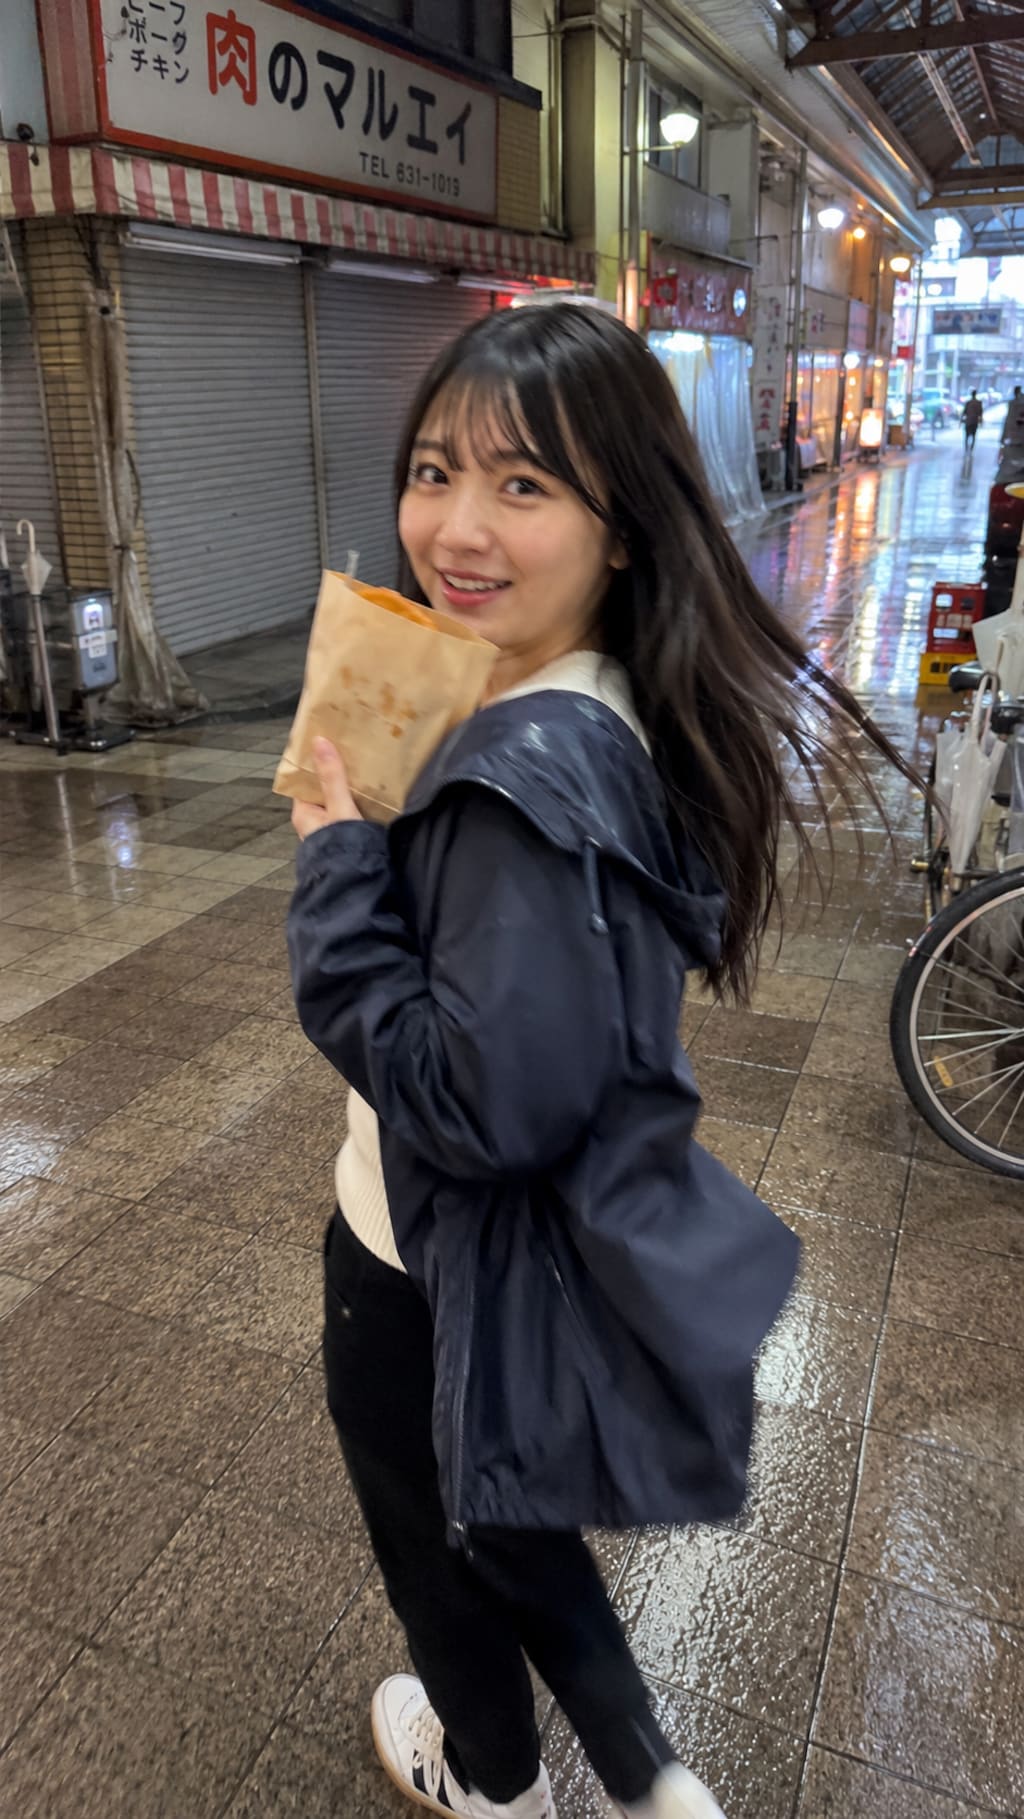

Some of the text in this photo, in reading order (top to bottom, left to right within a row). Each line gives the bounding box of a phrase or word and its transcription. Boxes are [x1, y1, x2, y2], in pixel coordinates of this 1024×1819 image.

[130, 50, 189, 84] チキン
[206, 9, 472, 166] 肉のマルエイ
[359, 151, 390, 179] TEL
